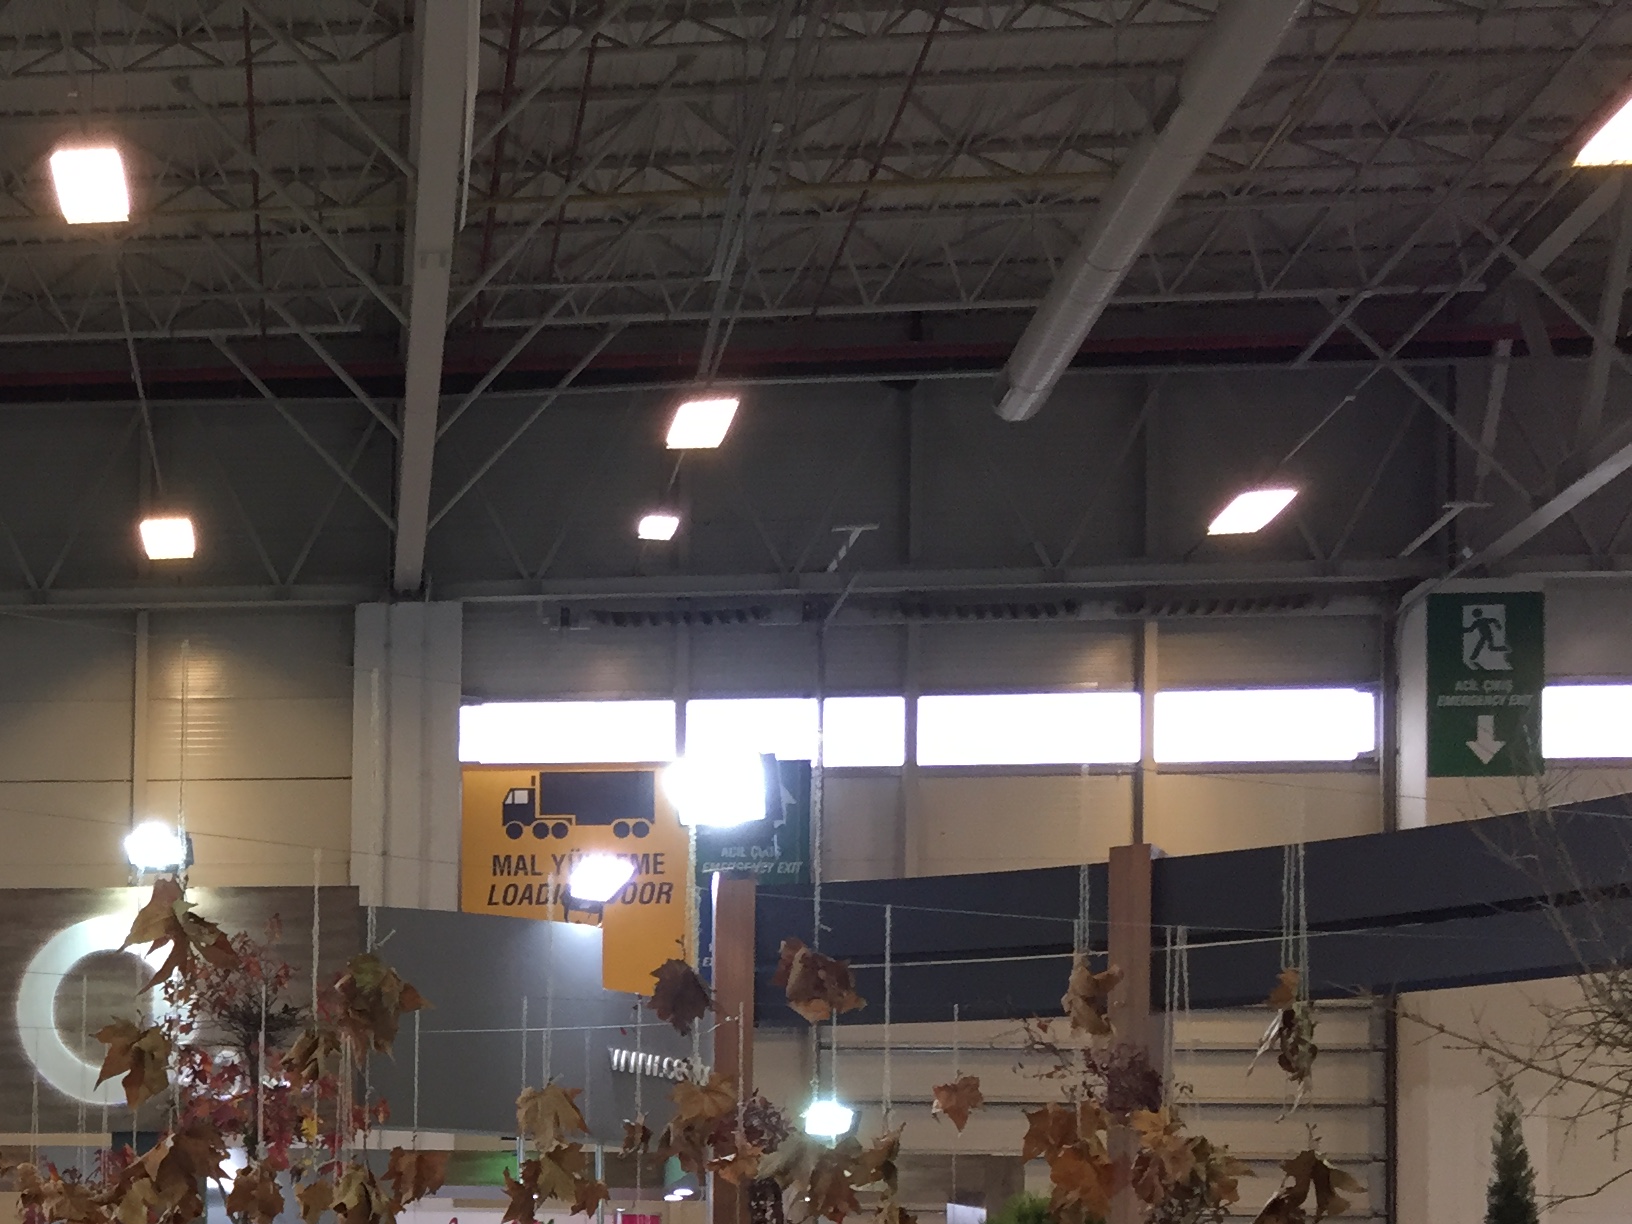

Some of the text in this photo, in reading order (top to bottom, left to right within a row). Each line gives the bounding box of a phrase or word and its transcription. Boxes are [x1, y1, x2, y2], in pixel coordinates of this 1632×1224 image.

[492, 854, 542, 876] MAL
[777, 861, 803, 873] EXIT
[487, 882, 673, 906] LOADI OOR
